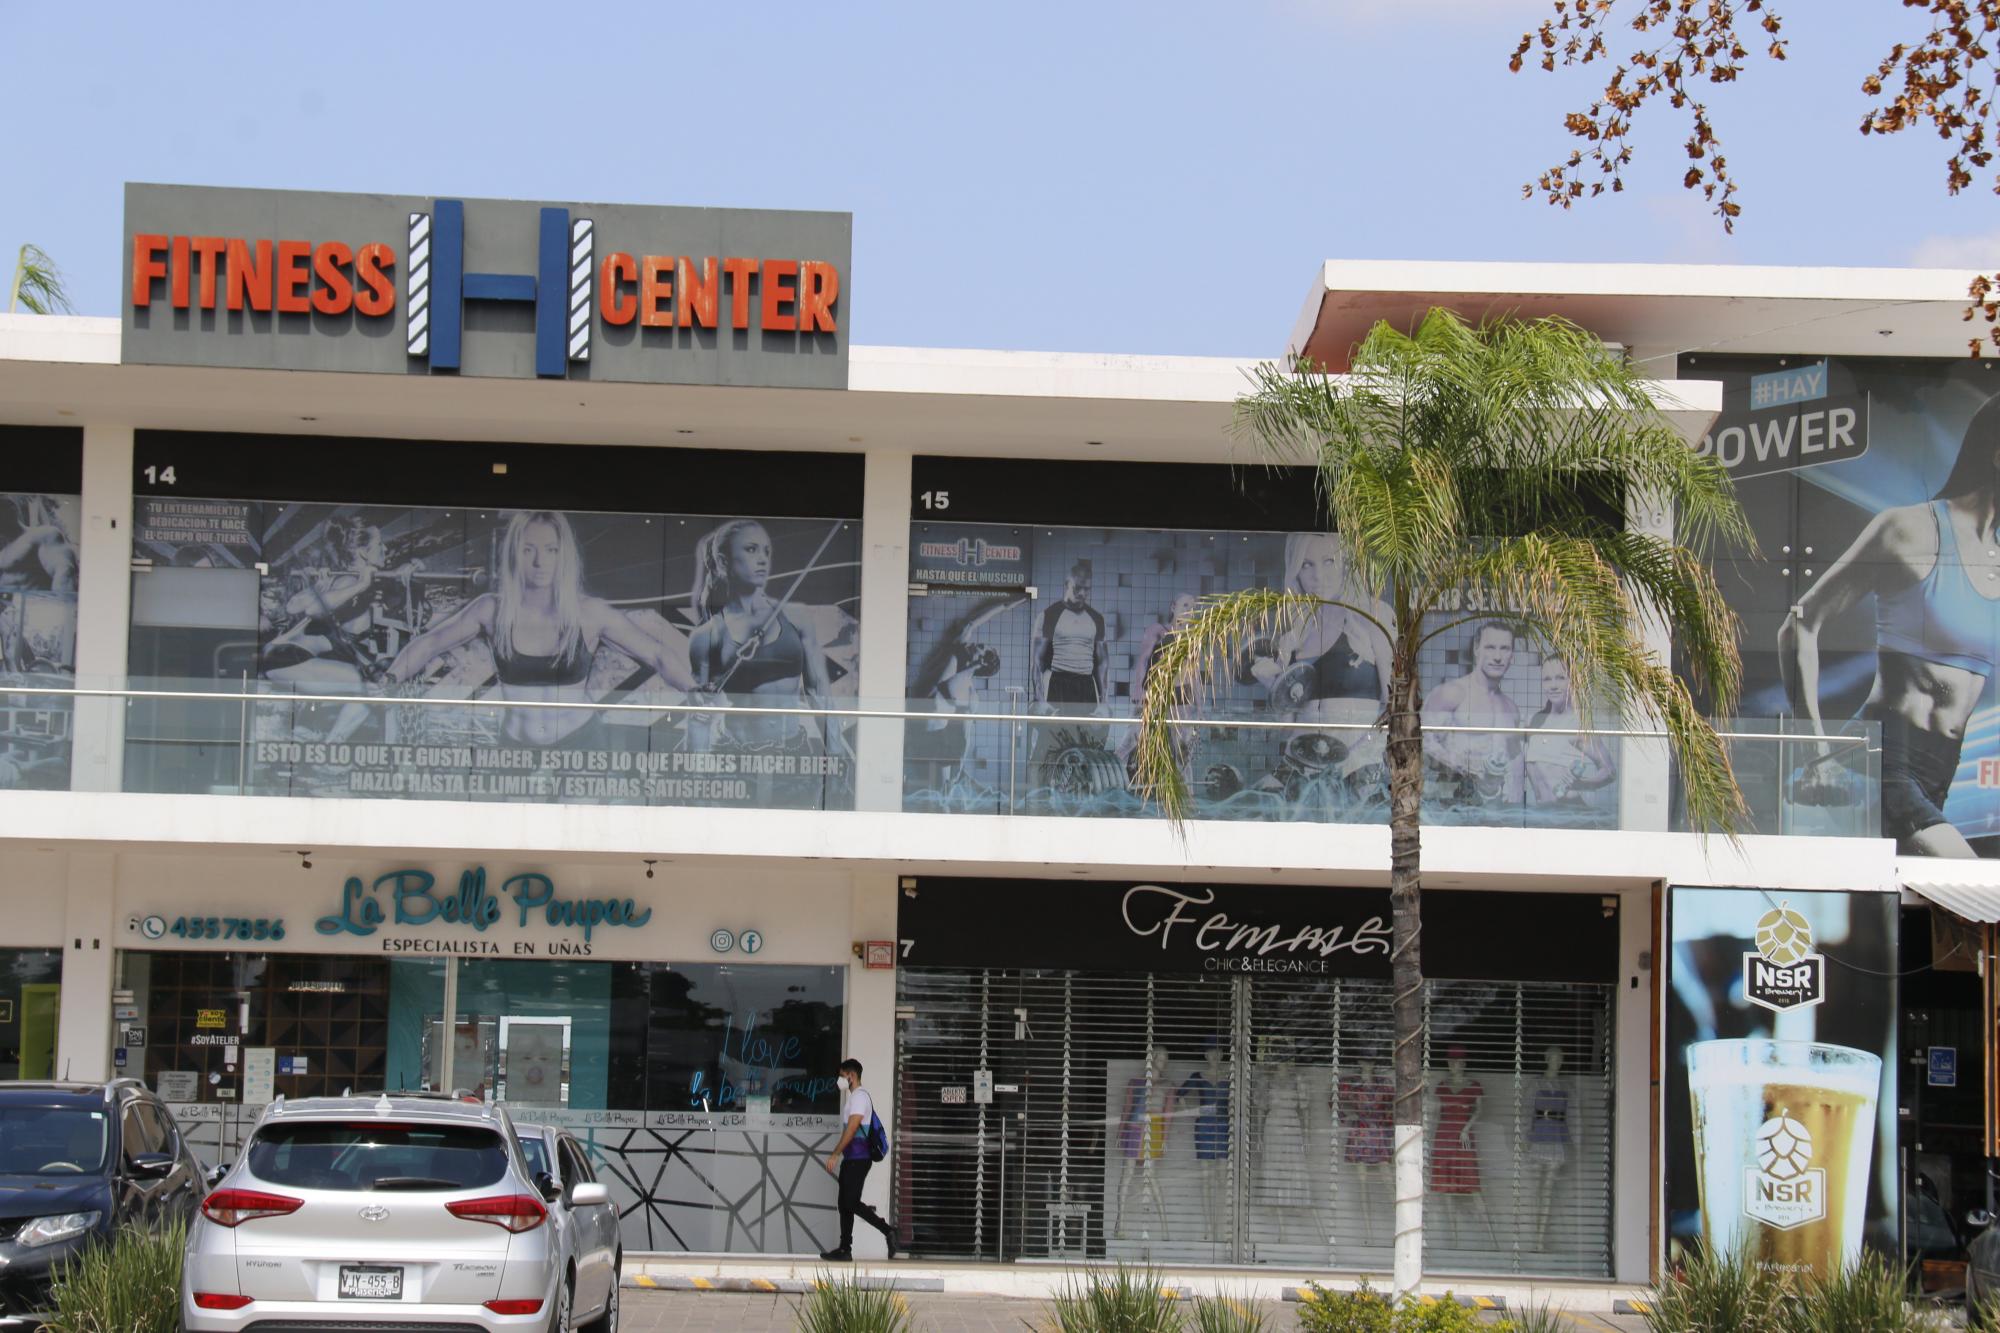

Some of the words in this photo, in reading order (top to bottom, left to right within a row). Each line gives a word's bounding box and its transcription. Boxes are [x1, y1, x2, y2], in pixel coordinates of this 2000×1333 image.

[132, 233, 397, 318] FITNESS
[600, 252, 839, 333] CENTER
[1755, 372, 1822, 404] #HAY
[144, 465, 177, 485] 14
[164, 504, 239, 515] ENTRENAMIENTO
[921, 491, 950, 510] 15
[150, 517, 207, 529] DEDICACION
[209, 519, 219, 529] TE
[221, 520, 246, 530] HACE
[144, 530, 154, 540] EL
[155, 531, 193, 541] CUERPO
[195, 532, 215, 542] QUE
[920, 543, 959, 558] FITNESS
[985, 546, 1020, 560] CENTER
[916, 569, 945, 580] HASTA
[948, 570, 966, 582] QUE
[968, 571, 977, 582] EL
[980, 572, 1025, 584] MUSCULO
[257, 743, 300, 763] ESTO
[305, 744, 328, 764] ES
[330, 745, 350, 764] LO
[354, 746, 389, 766] QUE
[392, 747, 412, 766] TE
[416, 747, 472, 767] GUSTA
[476, 749, 537, 769] HACER,
[541, 750, 583, 769] ESTO
[587, 751, 608, 770] ES
[612, 752, 631, 770] LO
[636, 752, 669, 773] QUE
[673, 753, 737, 773] PUEDES
[740, 755, 796, 774] HACER
[351, 772, 405, 792] HAZLO
[409, 774, 464, 793] HASTA
[469, 775, 486, 794] EL
[490, 775, 546, 795] LIMITE
[552, 778, 564, 796] Y
[565, 778, 641, 798] ESTARAS
[644, 779, 750, 799] SATISFECHO.
[315, 876, 386, 936] La
[372, 866, 501, 932] Belle
[501, 873, 652, 942] Poupee
[170, 916, 286, 941] 4557856
[382, 939, 500, 954] ESPECIALISTA
[514, 942, 535, 955] EN
[549, 938, 592, 956] UÑAS
[900, 939, 915, 958] 7
[1756, 961, 1812, 988] NSR
[1765, 988, 1802, 1003] Brewery
[741, 1010, 801, 1073] love
[1756, 1176, 1812, 1203] NSR
[341, 1274, 400, 1288] VJY-455-B
